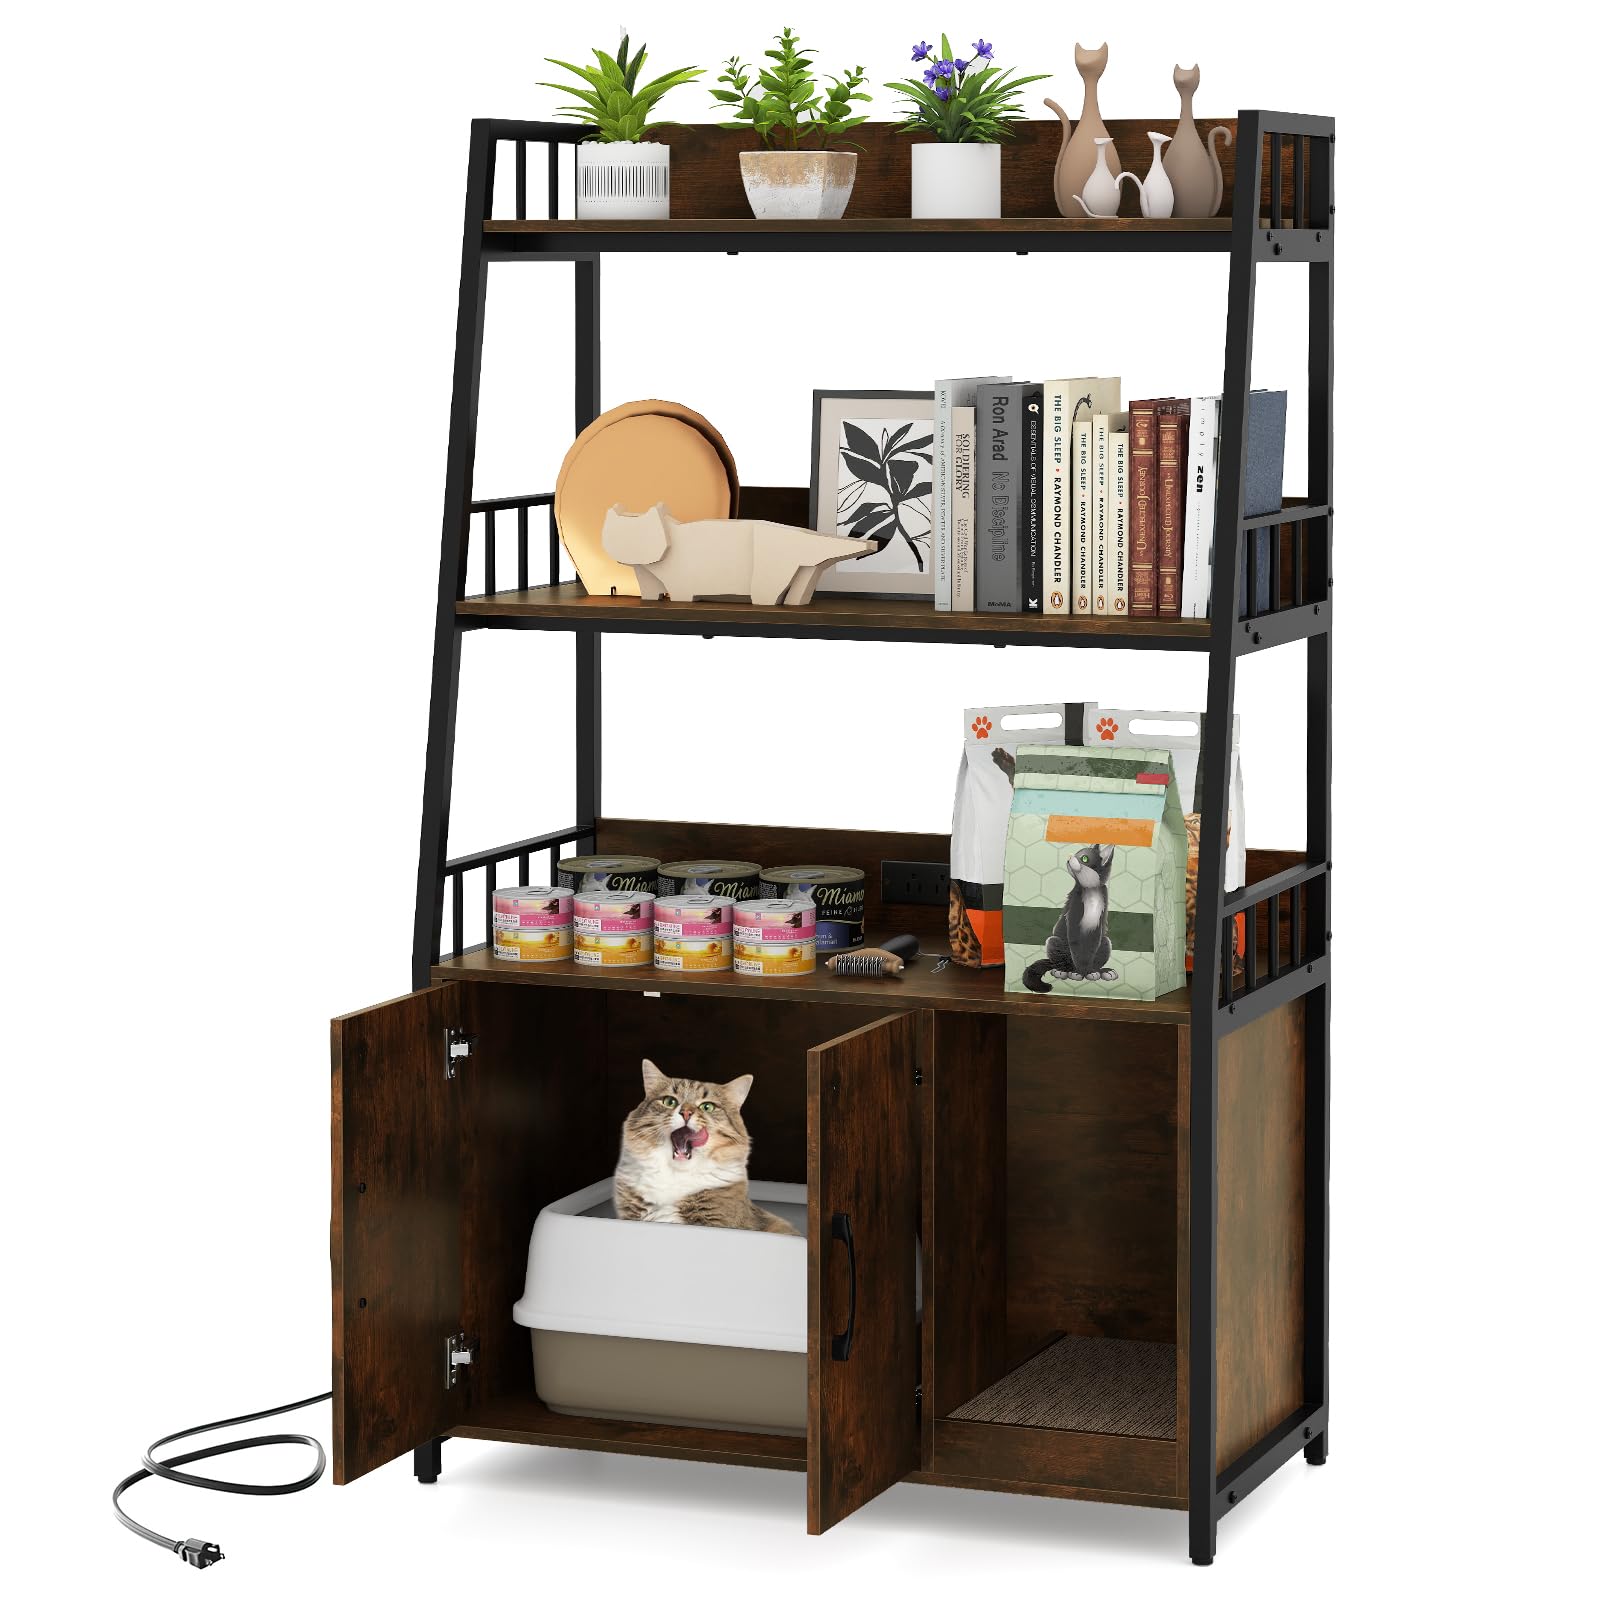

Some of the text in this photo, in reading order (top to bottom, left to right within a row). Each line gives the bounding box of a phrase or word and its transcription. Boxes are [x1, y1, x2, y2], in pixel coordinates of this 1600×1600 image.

[992, 396, 1009, 461] Ron Arad
[962, 434, 970, 498] SOLDIERING
[1030, 462, 1037, 472] OF
[1054, 395, 1062, 583] THE BIG SLEEP RAYMOND CHANDLER
[1136, 465, 1150, 500] JOURNEY
[988, 471, 1010, 562] No Discipline
[1162, 526, 1174, 558] JOURNEY
